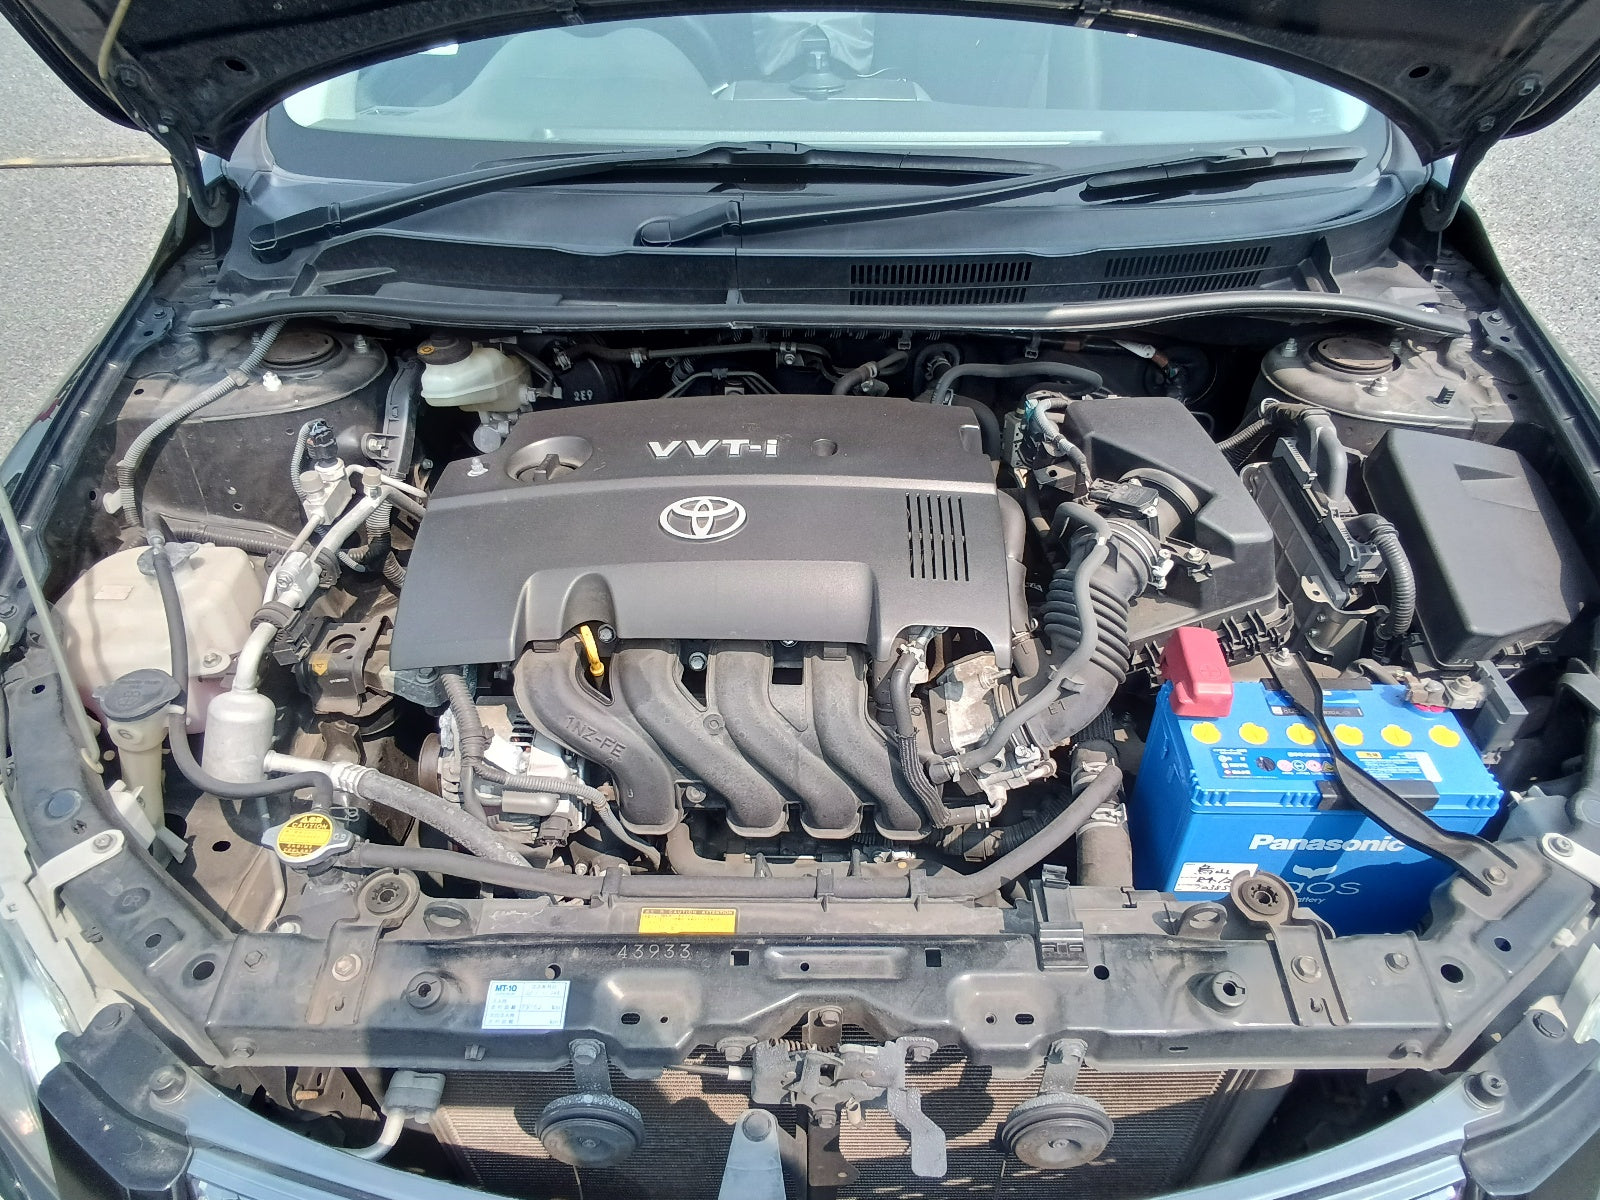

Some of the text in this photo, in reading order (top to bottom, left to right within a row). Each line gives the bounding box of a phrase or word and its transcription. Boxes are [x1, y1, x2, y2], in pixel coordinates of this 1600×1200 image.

[648, 439, 778, 459] VVT-i
[565, 715, 627, 758] 1NZ-FE
[291, 822, 328, 830] CAUTION
[1248, 833, 1406, 852] Panasonic
[1286, 881, 1362, 895] aos
[1296, 895, 1327, 904] attery
[616, 943, 692, 960] 43933
[494, 984, 518, 992] MT-10
